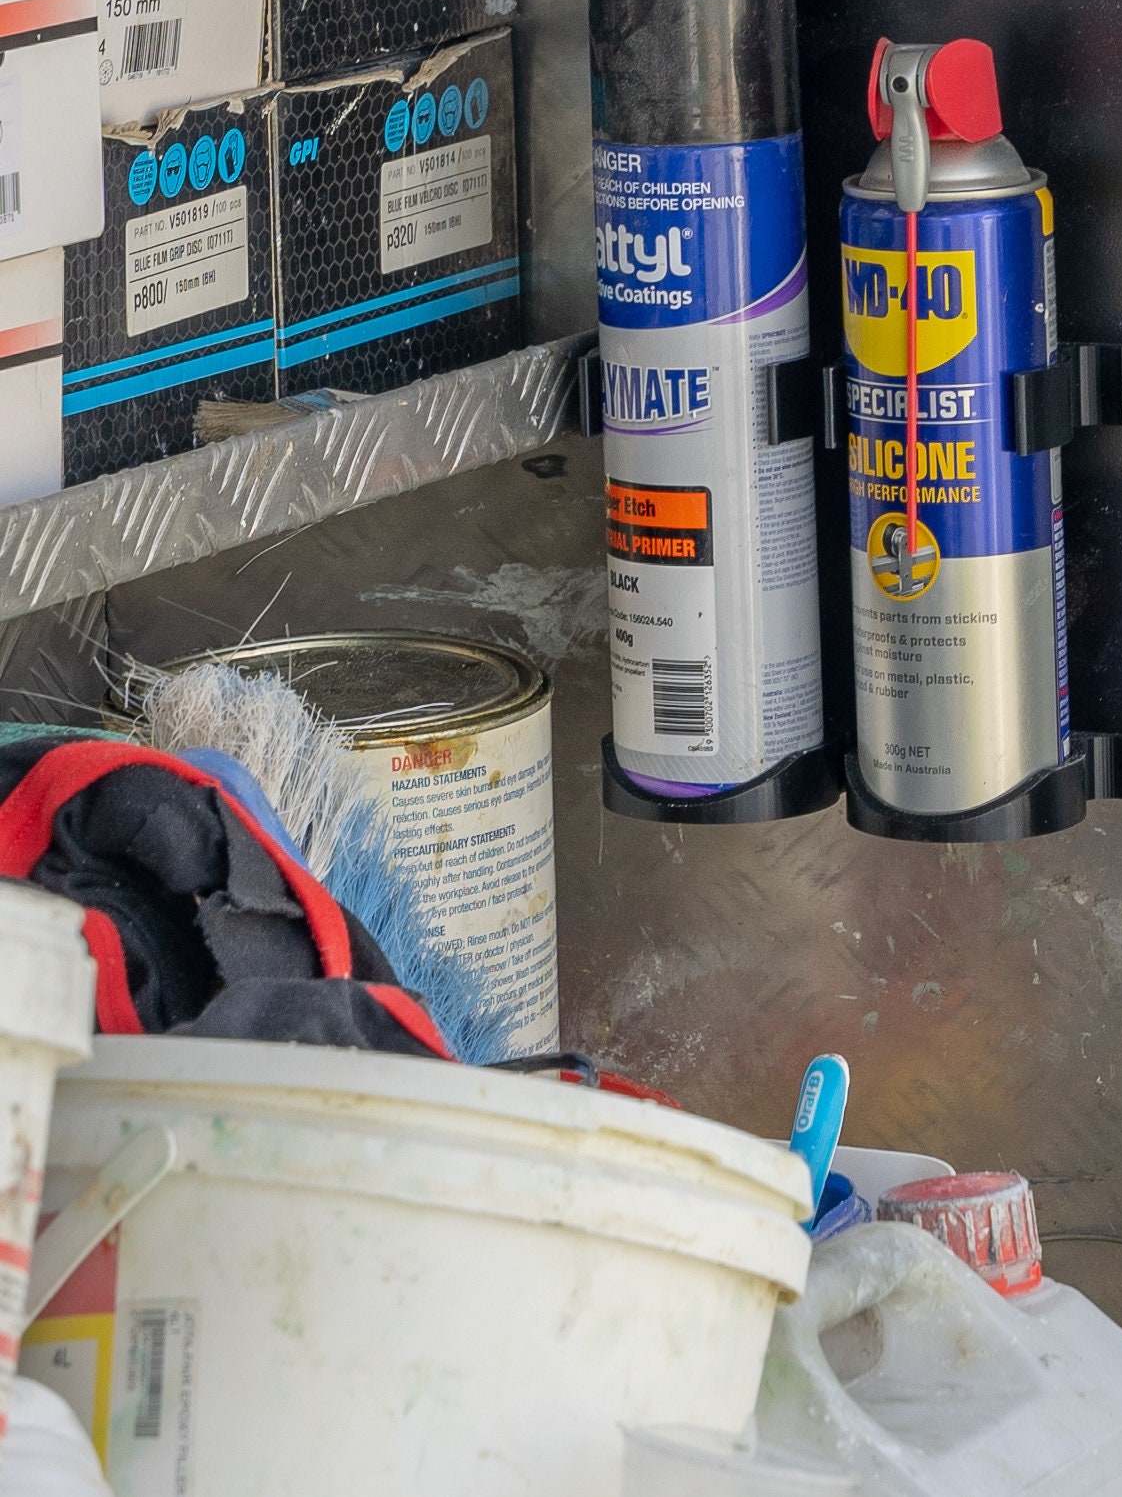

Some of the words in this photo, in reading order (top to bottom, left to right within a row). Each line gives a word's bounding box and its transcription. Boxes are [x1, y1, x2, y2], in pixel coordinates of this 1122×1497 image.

[290, 137, 319, 166] GPI
[594, 148, 642, 173] ANGER
[420, 154, 456, 175] V501814
[388, 199, 402, 214] BLUE
[404, 195, 418, 209] FILM
[420, 187, 442, 205] VELCRO
[443, 181, 458, 197] DISC
[624, 181, 639, 194] OF
[642, 182, 711, 195] CHILDREN
[628, 198, 679, 211] BEFORE
[682, 196, 745, 211] OPENING
[134, 223, 153, 239] PART
[155, 220, 167, 234] NO.
[169, 204, 209, 229] V501819
[424, 220, 447, 236] 150mm
[135, 257, 151, 273] BLUE
[153, 251, 167, 267] FILM
[169, 246, 185, 262] GRIP
[187, 240, 203, 256] DISC
[175, 276, 200, 294] 150mm
[845, 258, 963, 320] WD-40
[615, 283, 693, 310] Coatings
[848, 433, 976, 481] SILICONE
[867, 483, 981, 503] PERFORMANCE
[624, 497, 656, 517] Etch
[632, 535, 695, 557] PRIMER
[610, 570, 639, 593] BLACK
[880, 612, 908, 623] parts
[912, 613, 941, 625] from
[945, 611, 997, 625] sticking
[616, 627, 634, 647] 400g
[899, 635, 907, 645] &
[910, 636, 966, 647] protects
[875, 649, 922, 662] moisture
[875, 671, 885, 679] on
[887, 673, 923, 686] metal,
[926, 673, 974, 686] plastic,
[876, 686, 909, 699] rubber
[392, 750, 452, 772] DANGER
[885, 743, 906, 759] 300g
[909, 746, 930, 758] NET
[873, 759, 892, 771] Made
[894, 764, 903, 772] in
[905, 764, 951, 775] Australia
[392, 778, 431, 791] HAZARD
[433, 766, 487, 786] STATEMENTS
[392, 794, 425, 808] Causes
[426, 791, 454, 803] severe
[456, 786, 471, 798] skin
[394, 837, 469, 858] PRECAUTIONARY
[470, 824, 516, 847] STATEMENTS
[445, 856, 468, 868] reach
[469, 853, 477, 862] of
